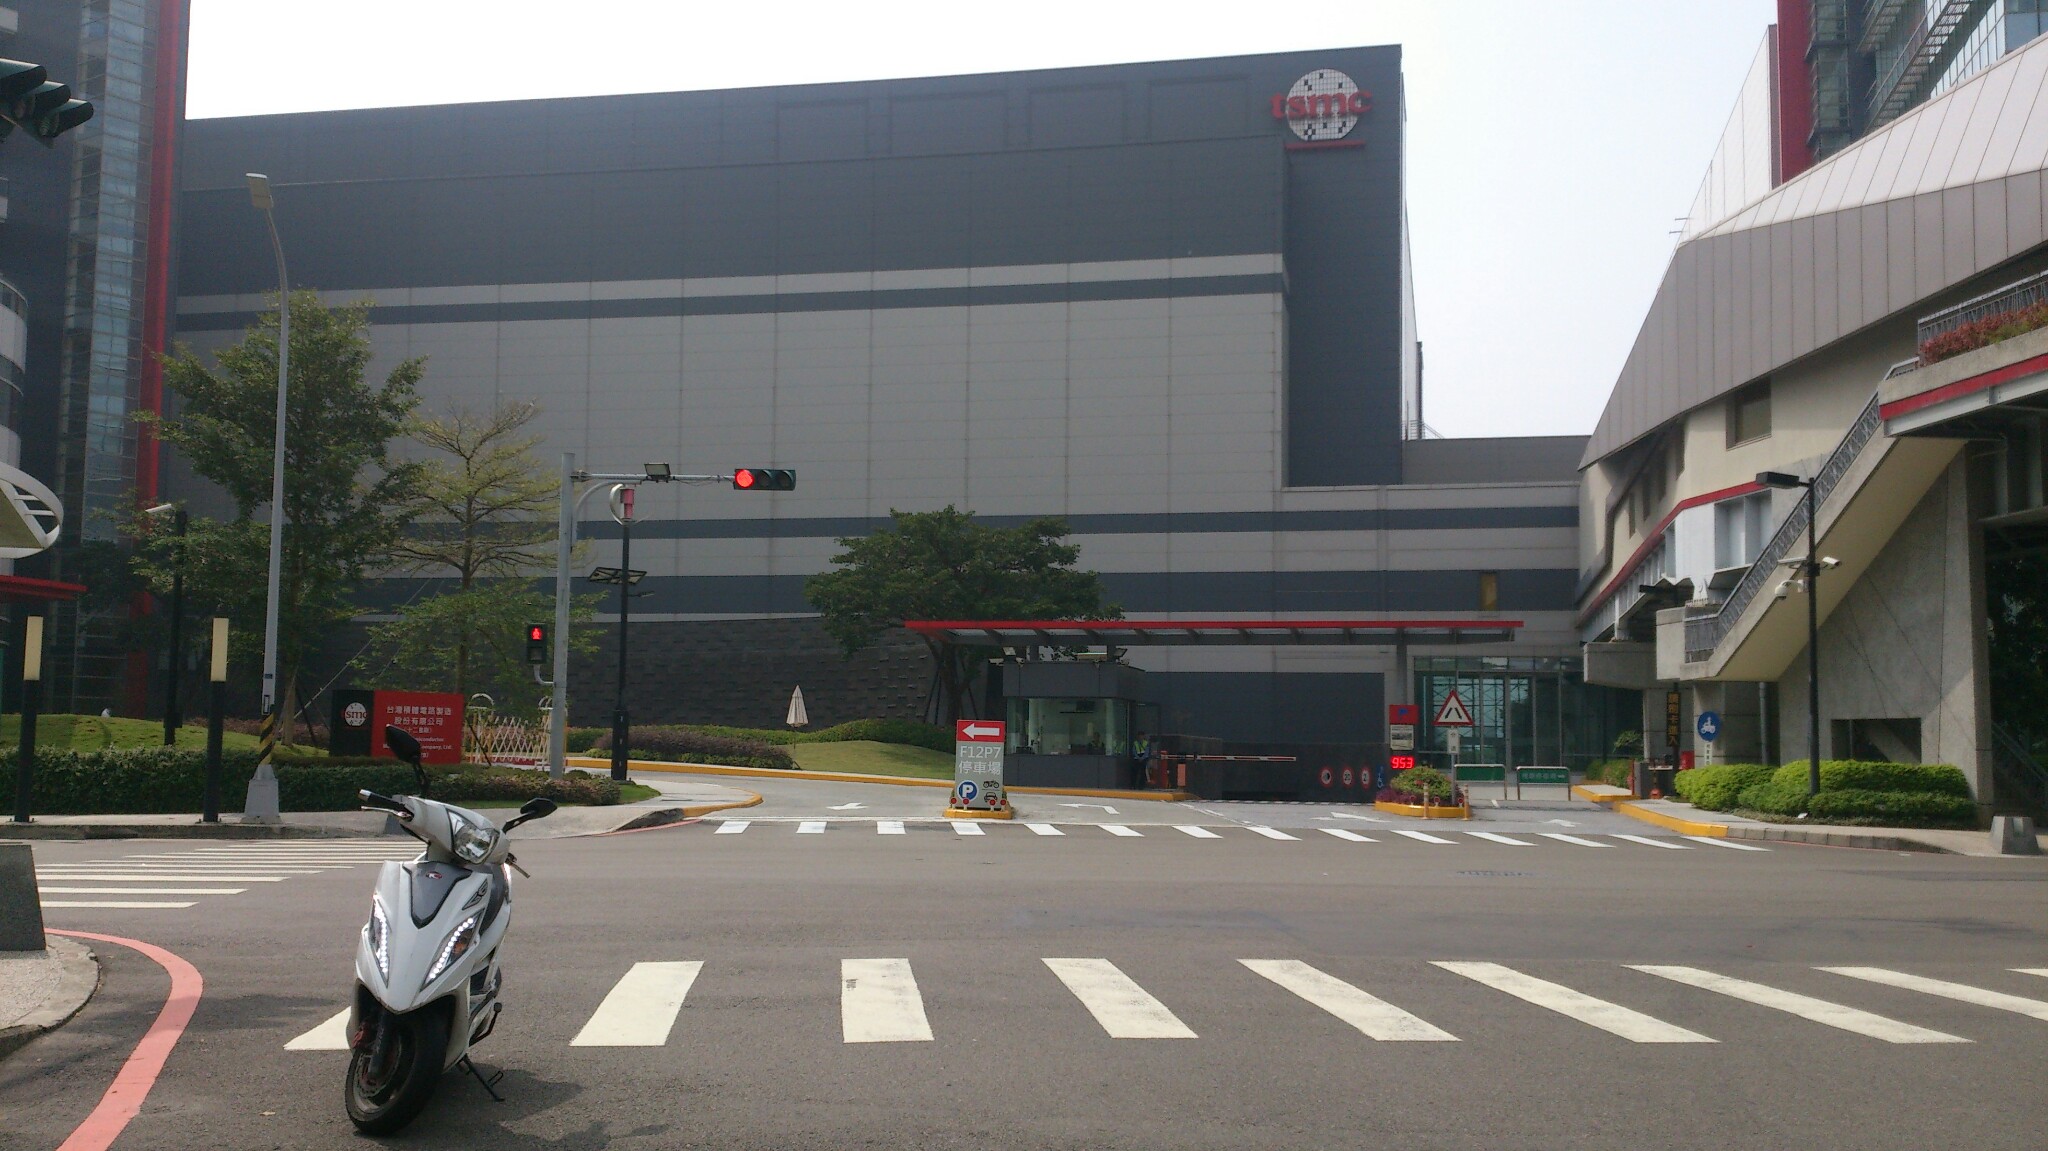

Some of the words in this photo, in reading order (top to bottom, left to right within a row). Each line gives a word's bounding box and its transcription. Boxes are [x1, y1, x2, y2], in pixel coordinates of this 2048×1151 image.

[1270, 91, 1373, 119] tsmc
[394, 717, 443, 726] 股份有限公司
[961, 746, 1001, 758] F12P7
[959, 761, 1001, 775] 停車場
[1391, 757, 1413, 769] 953
